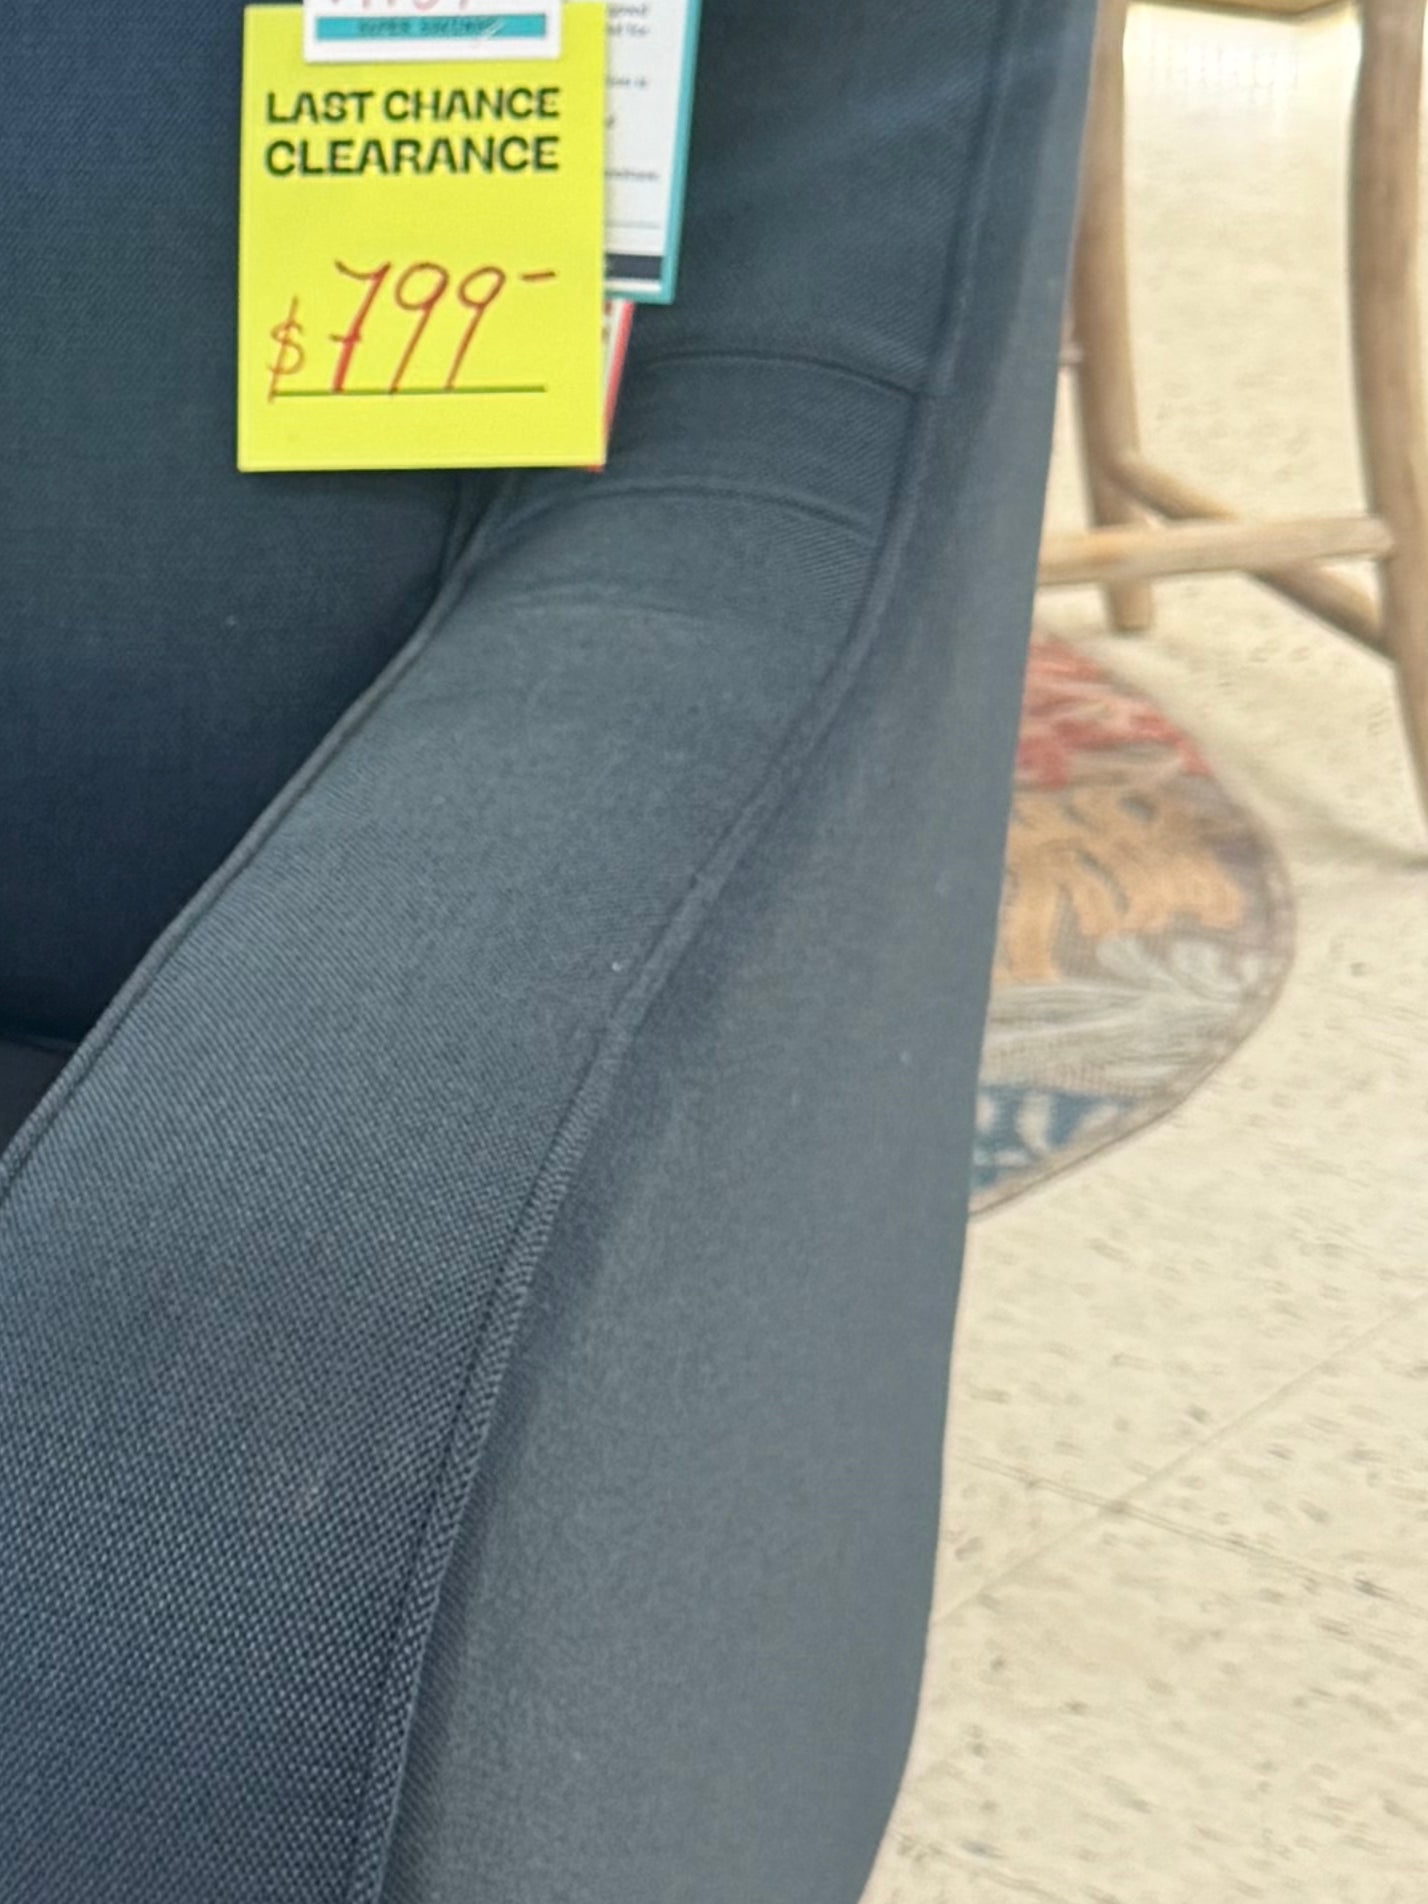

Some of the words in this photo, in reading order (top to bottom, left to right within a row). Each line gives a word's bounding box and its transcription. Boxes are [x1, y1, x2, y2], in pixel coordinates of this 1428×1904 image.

[265, 91, 375, 124] LAST
[384, 87, 561, 123] CHANCE
[265, 135, 561, 176] CLEARANCE
